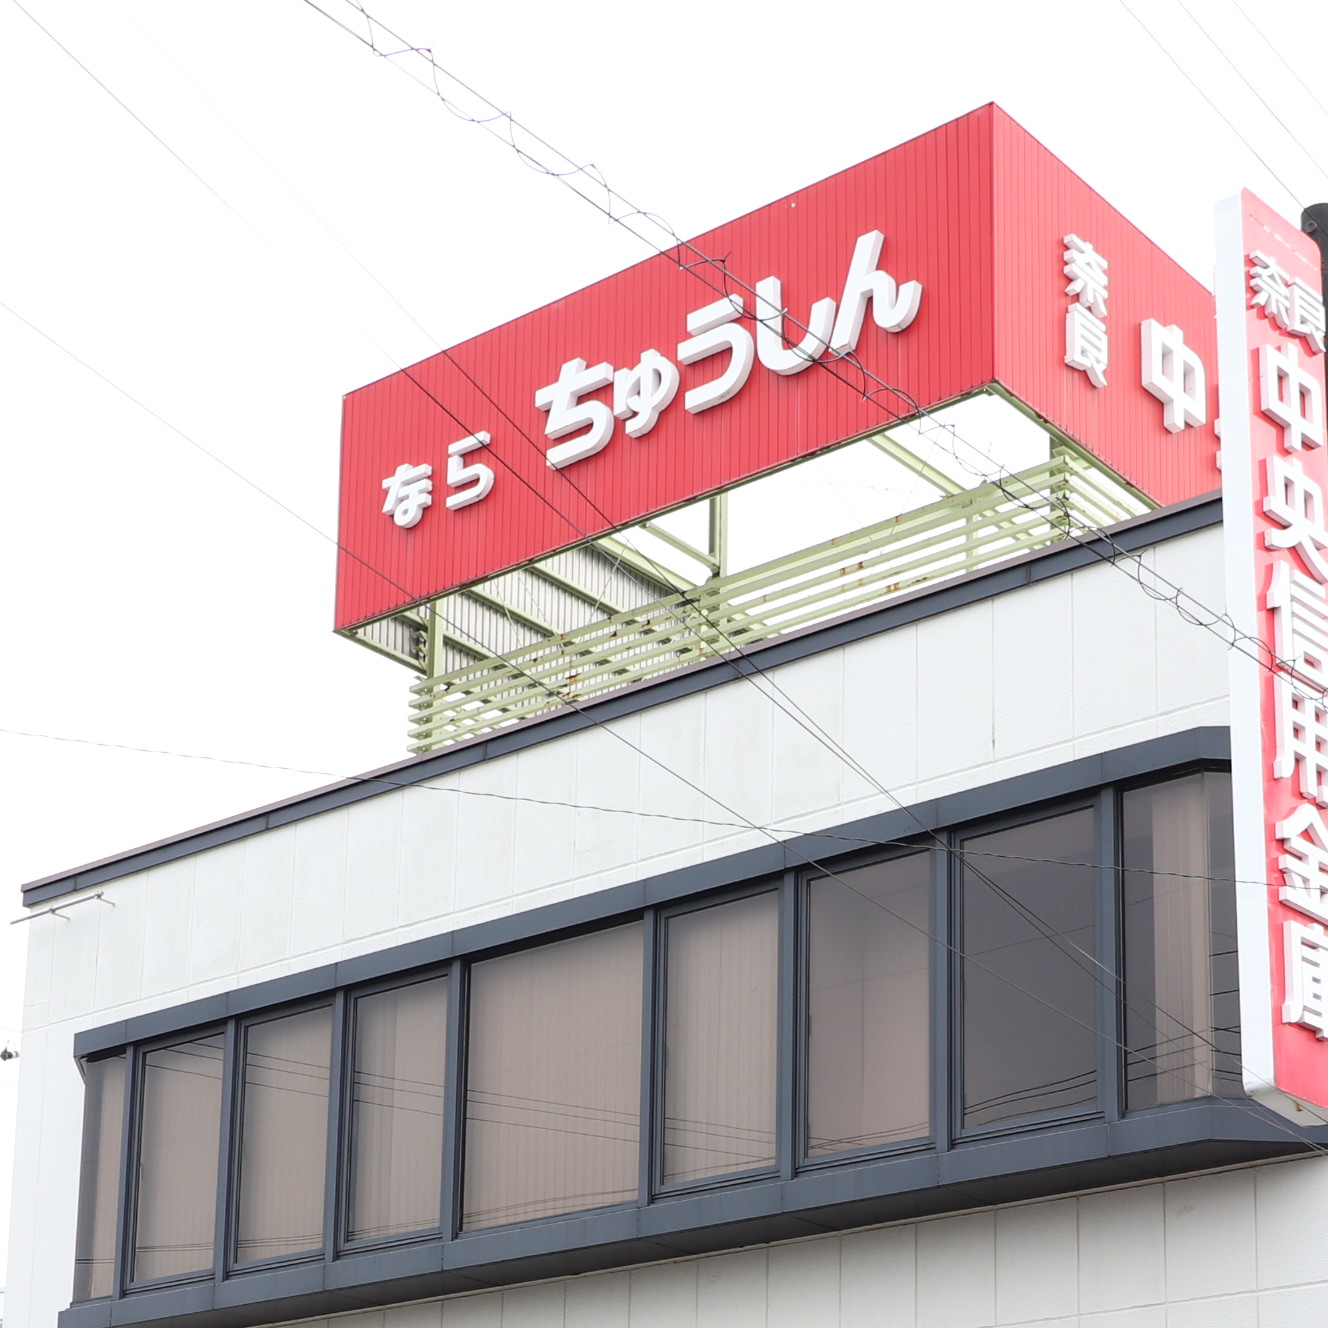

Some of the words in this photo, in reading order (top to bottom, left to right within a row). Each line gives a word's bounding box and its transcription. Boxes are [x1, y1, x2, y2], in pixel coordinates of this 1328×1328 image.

[381, 430, 496, 529] なら
[534, 228, 924, 471] ちゅうしん
[1063, 232, 1109, 389] 奈良
[1140, 316, 1221, 471] 中
